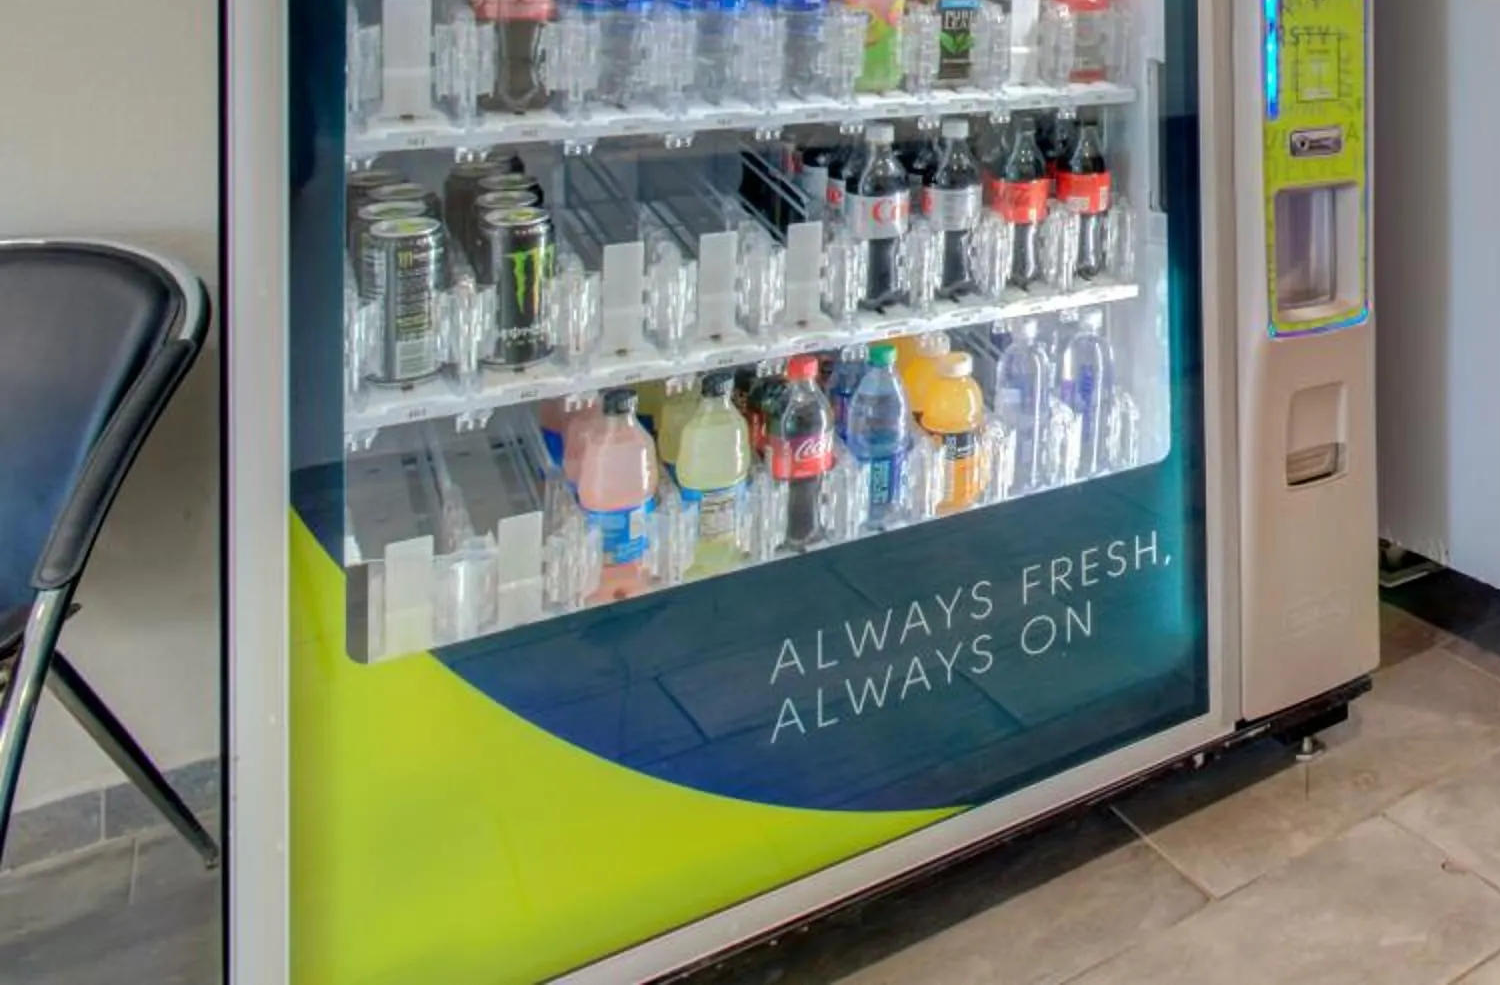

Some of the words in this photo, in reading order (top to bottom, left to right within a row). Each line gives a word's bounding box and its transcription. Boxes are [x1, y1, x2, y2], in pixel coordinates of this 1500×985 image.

[769, 580, 994, 685] ALWAYS
[1021, 530, 1171, 606] FRESH,
[769, 634, 994, 744] ALWAYS
[1020, 600, 1092, 654] ON
